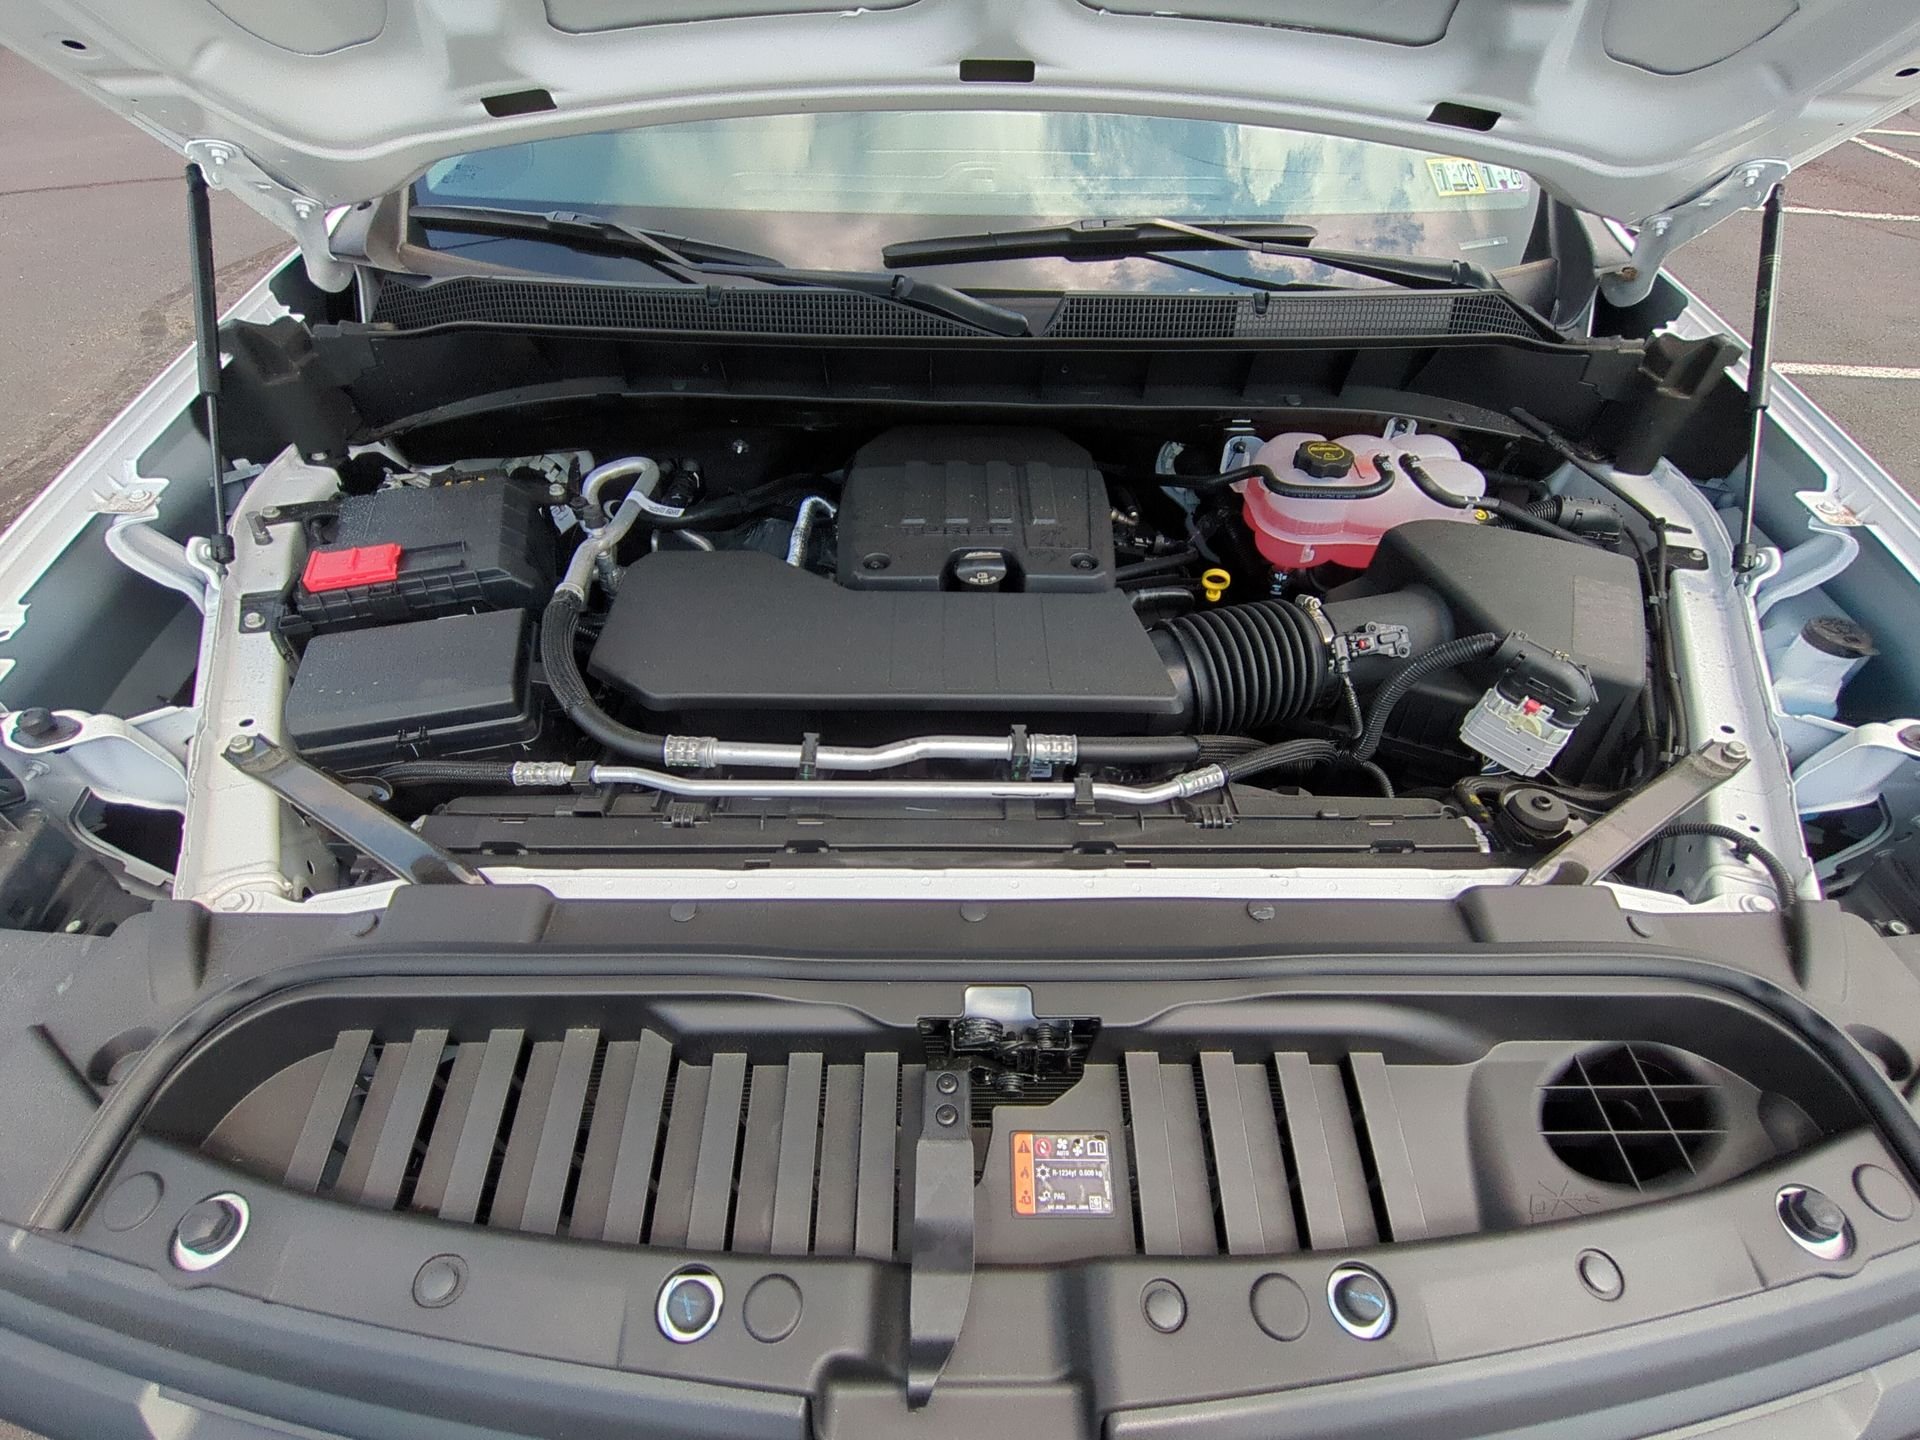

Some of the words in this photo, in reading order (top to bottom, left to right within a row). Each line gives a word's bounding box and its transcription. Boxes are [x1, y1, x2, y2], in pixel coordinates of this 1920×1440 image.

[1461, 163, 1479, 187] 26
[1052, 1168, 1077, 1178] R-1234yf
[1095, 1168, 1103, 1178] kg
[1053, 1192, 1066, 1200] PAG
